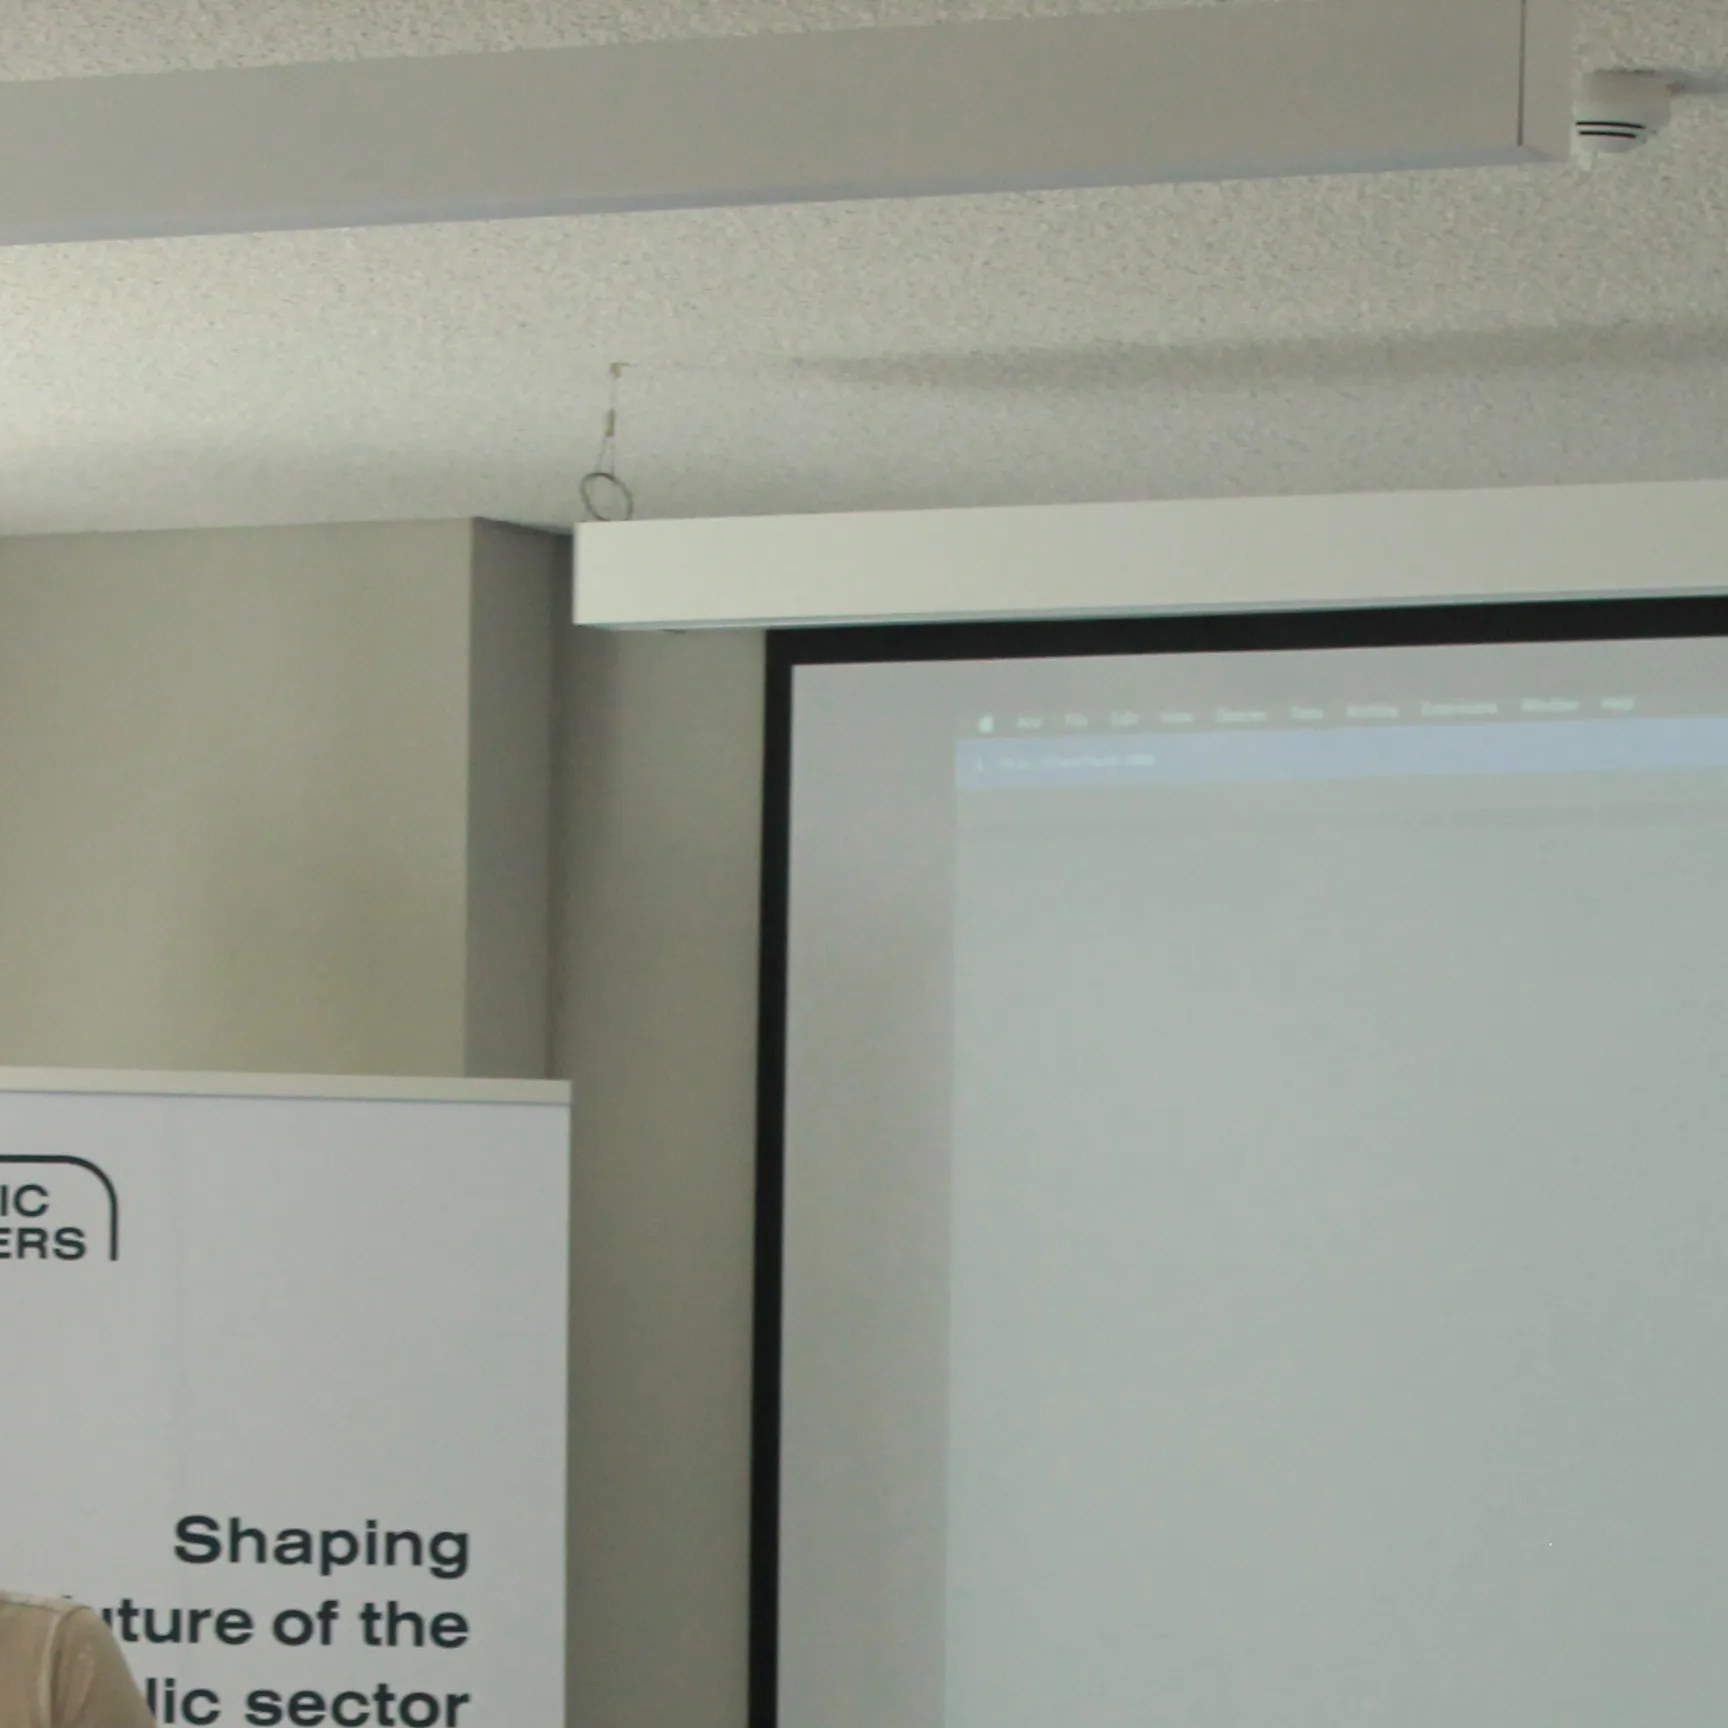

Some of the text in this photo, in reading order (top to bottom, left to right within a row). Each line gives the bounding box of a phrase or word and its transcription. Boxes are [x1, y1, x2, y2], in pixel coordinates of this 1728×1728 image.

[173, 1514, 470, 1580] Shaping
[101, 1598, 470, 1649] ture of the
[146, 1677, 221, 1726] lic
